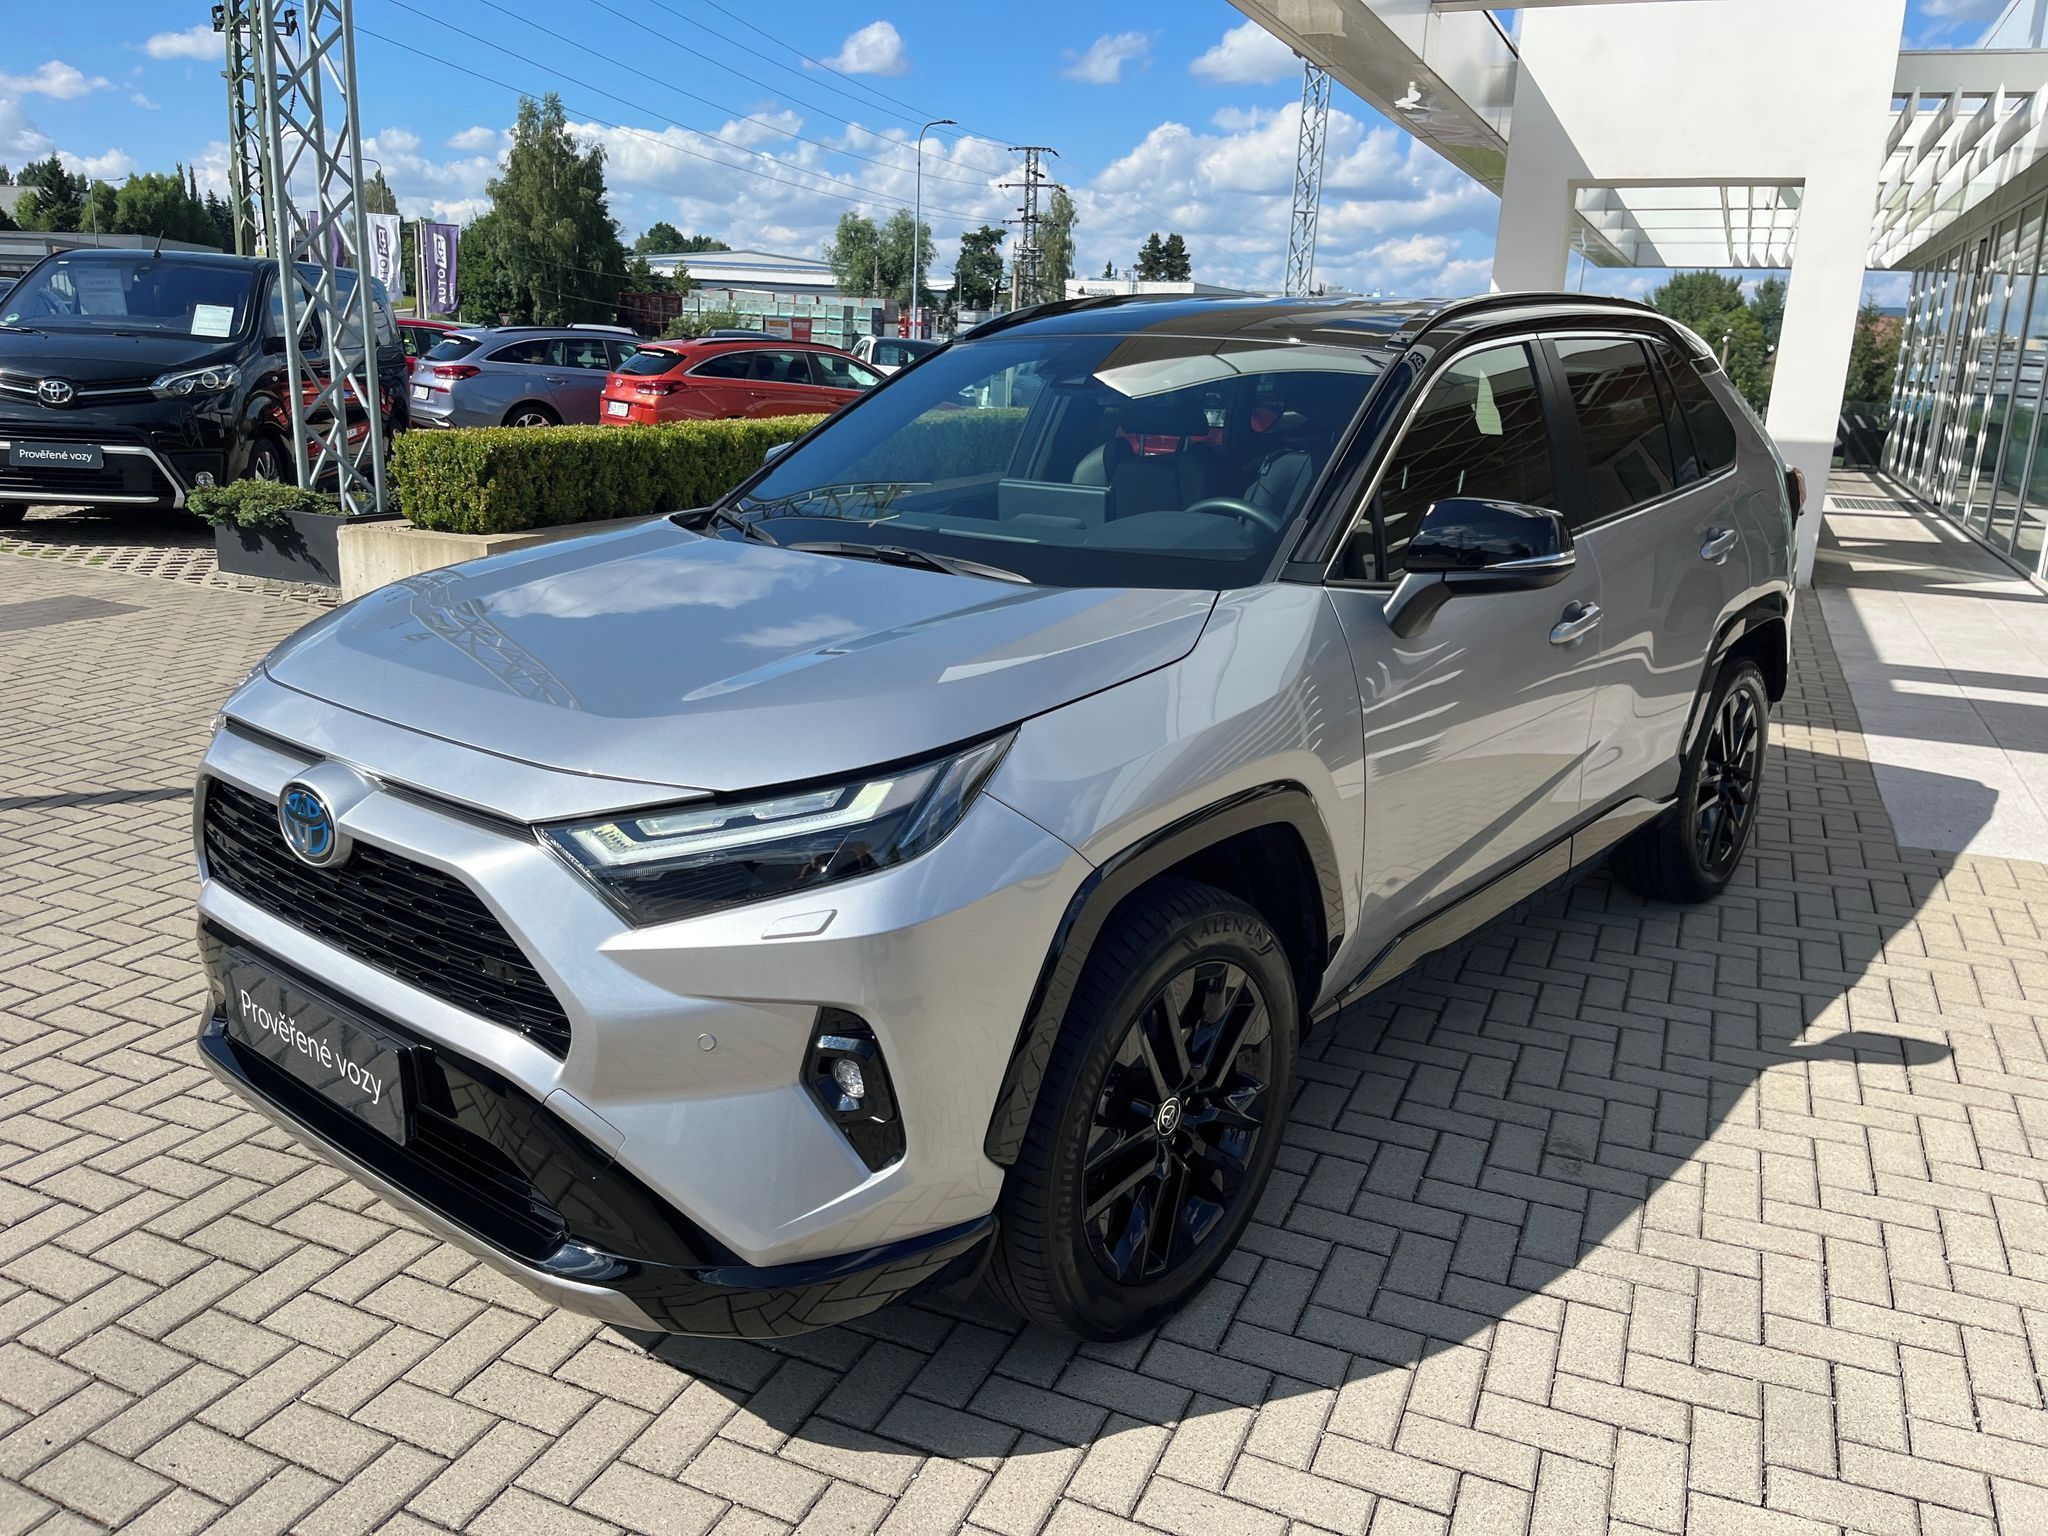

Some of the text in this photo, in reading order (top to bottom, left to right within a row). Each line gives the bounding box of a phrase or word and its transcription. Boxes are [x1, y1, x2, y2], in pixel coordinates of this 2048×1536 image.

[437, 269, 447, 304] AUTO
[19, 448, 93, 463] Prověřené vozy
[1200, 916, 1264, 942] ALENZA
[240, 989, 381, 1104] Prověřené vozy
